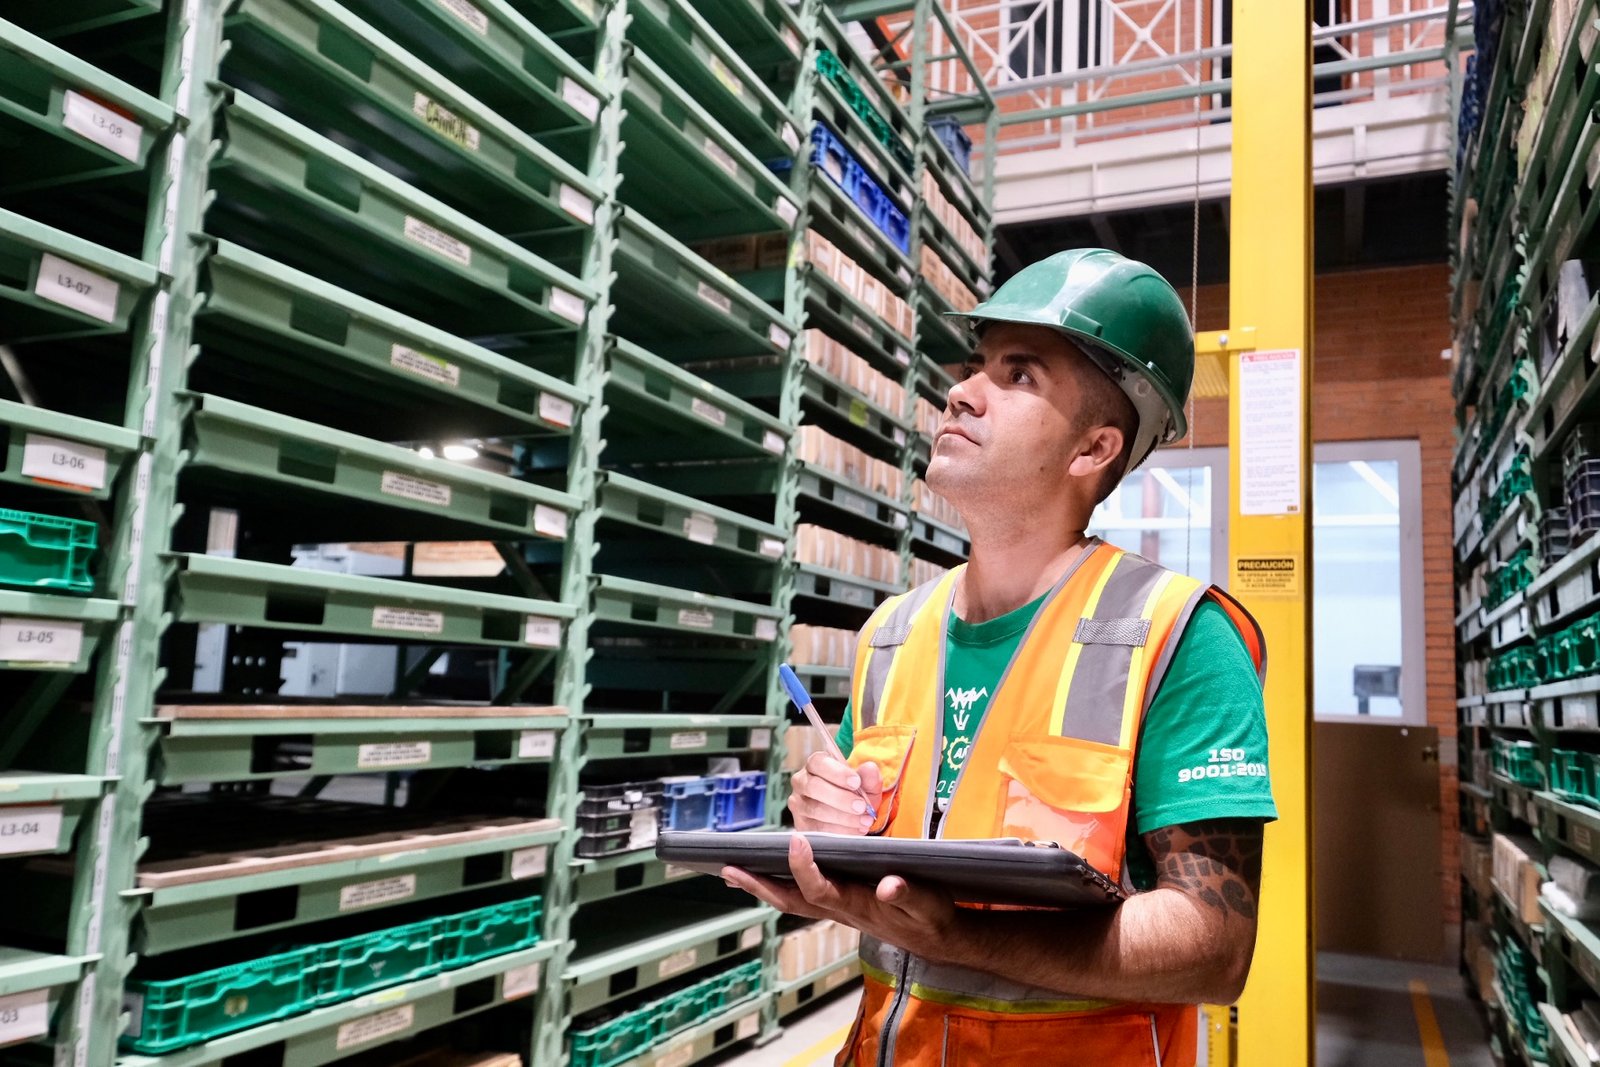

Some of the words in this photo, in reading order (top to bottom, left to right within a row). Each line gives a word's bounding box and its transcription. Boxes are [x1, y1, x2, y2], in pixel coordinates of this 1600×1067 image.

[92, 112, 123, 138] L3-08
[58, 274, 92, 296] L3-07
[52, 452, 85, 470] L3-06
[1238, 560, 1294, 570] PRECAUCIÓN
[17, 629, 54, 644] L3-05
[0, 822, 39, 837] L3-04
